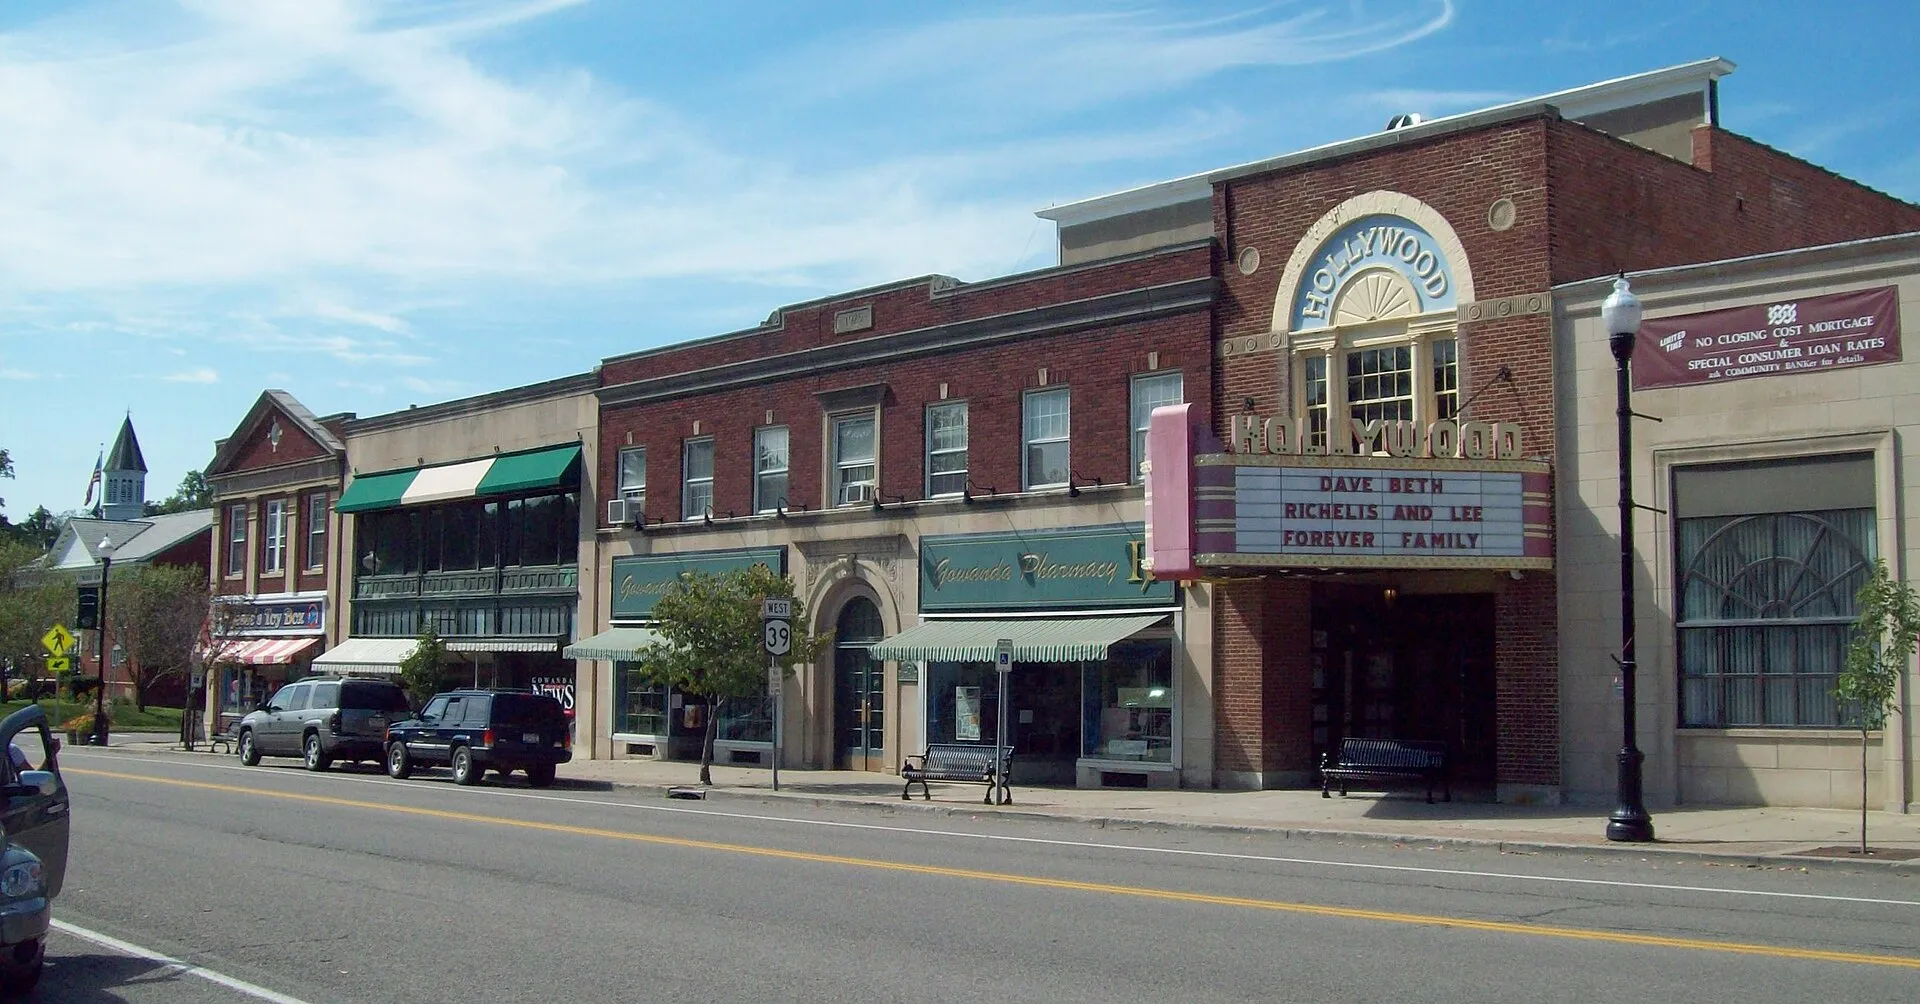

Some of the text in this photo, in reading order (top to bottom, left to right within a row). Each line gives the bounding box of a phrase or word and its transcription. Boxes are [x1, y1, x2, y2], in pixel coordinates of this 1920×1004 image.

[1302, 226, 1449, 320] HOLLYWOOD
[1696, 316, 1875, 348] NO CLOSING COST MORTGAGE
[1780, 338, 1790, 348] &
[1688, 337, 1885, 370] SPECIAL CONSUMER LOAN RATES
[1725, 364, 1780, 377] COMMUNITY
[1838, 355, 1864, 364] details
[1231, 415, 1523, 460] HOLLYWOOD
[1320, 476, 1443, 494] DAVE BETH
[1393, 505, 1433, 521] AND
[1450, 506, 1483, 522] LEE
[1284, 530, 1479, 550] FOREVER FAMILY
[935, 552, 1119, 592] Gowanda Pharmacy
[283, 607, 305, 625] Box
[768, 603, 787, 614] WEST
[767, 627, 789, 648] 39
[531, 676, 573, 684] GOWANDA
